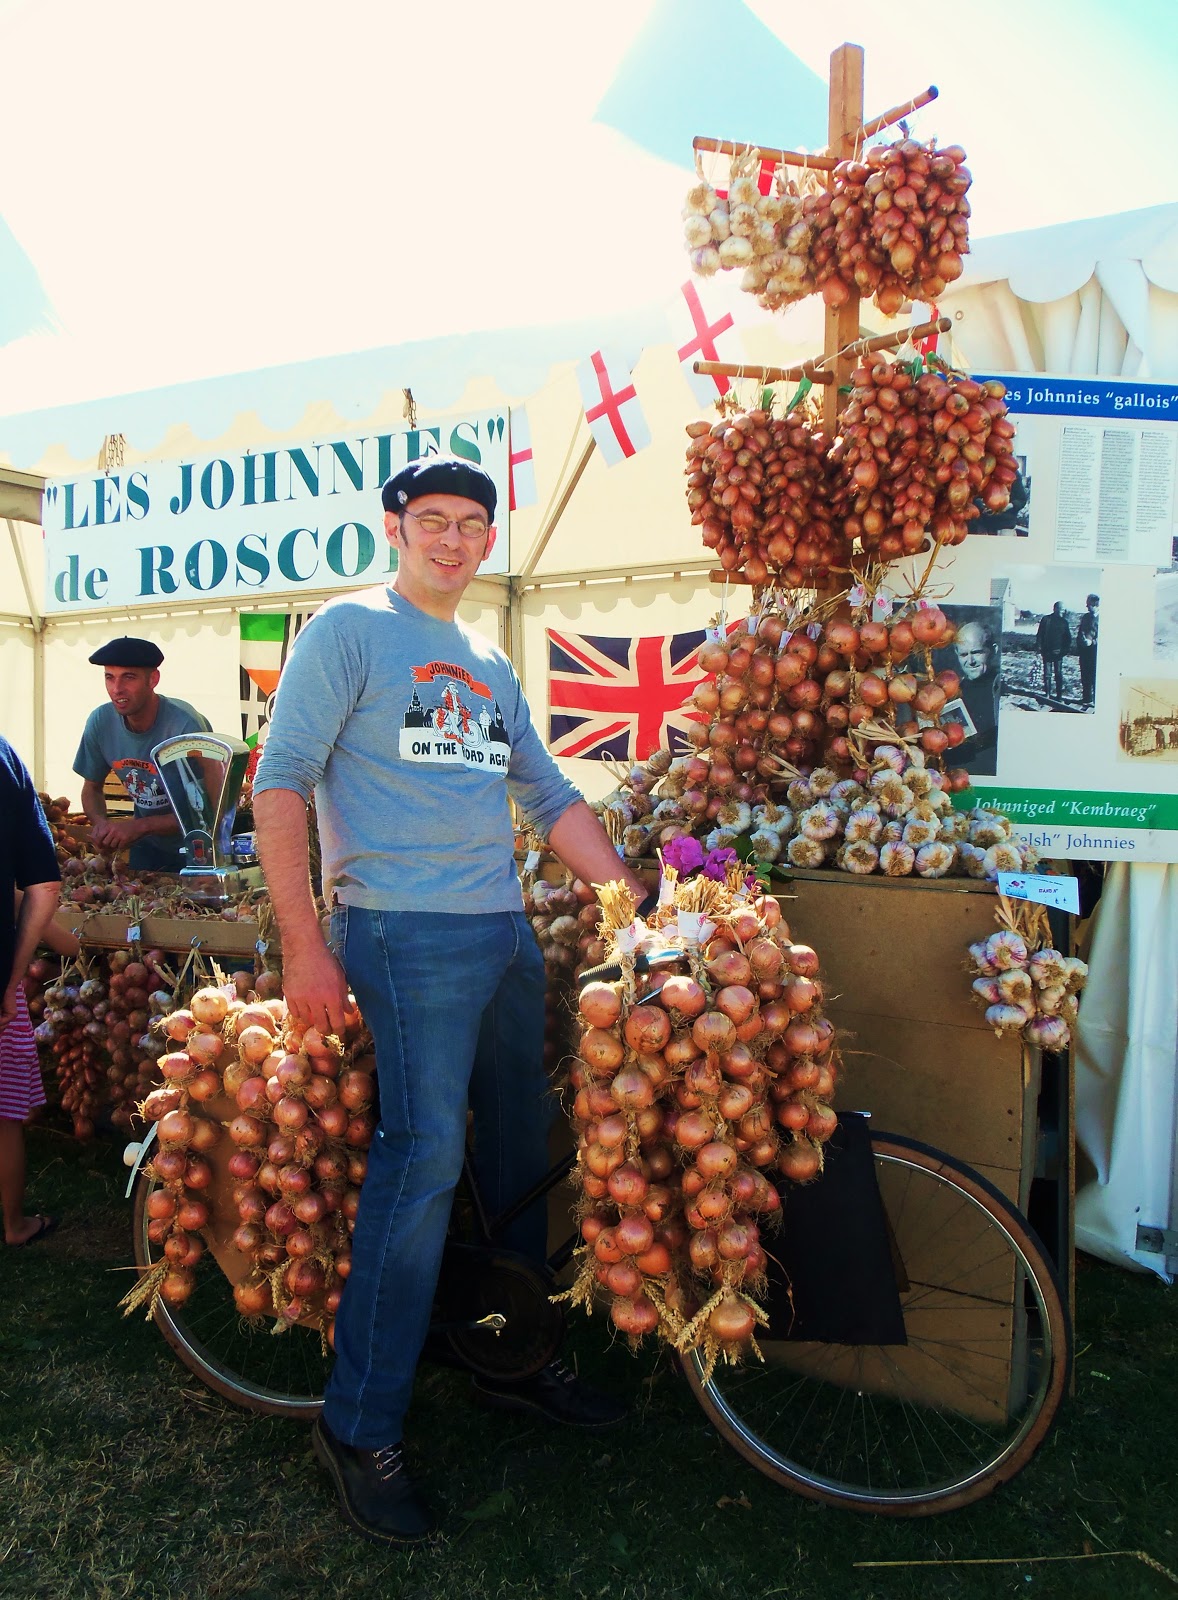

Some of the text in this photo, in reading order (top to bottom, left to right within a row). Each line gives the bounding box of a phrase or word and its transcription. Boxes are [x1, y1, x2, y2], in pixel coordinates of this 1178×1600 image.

[1005, 390, 1022, 401] es
[1026, 387, 1101, 405] Johnnies
[54, 521, 399, 604] de ROSCO
[412, 741, 431, 756] ON
[434, 742, 458, 755] THE
[1065, 833, 1136, 850] Johnnies
